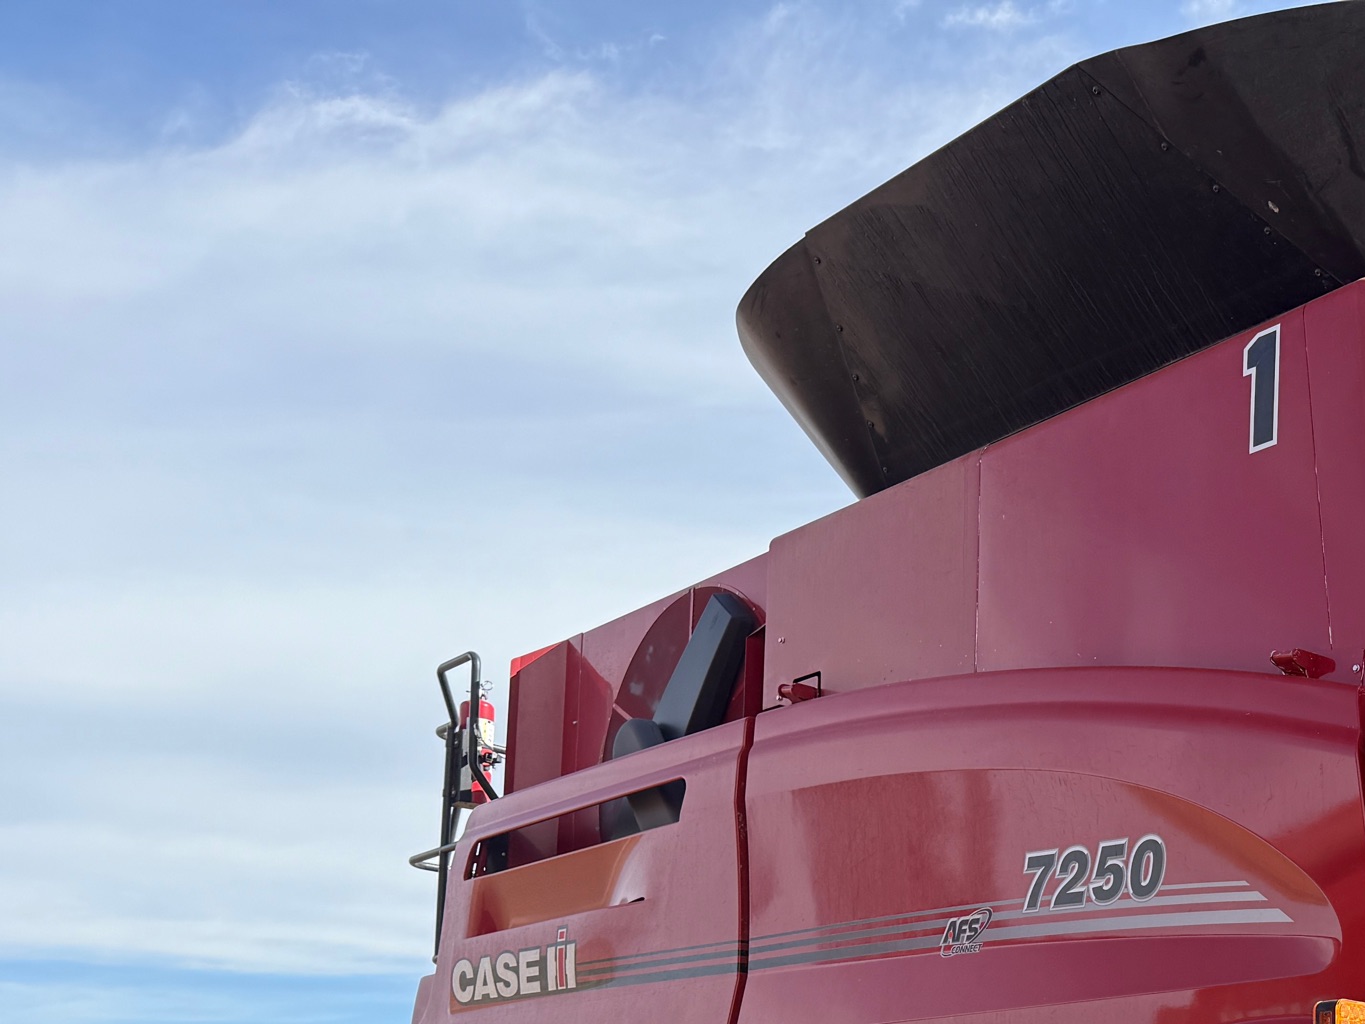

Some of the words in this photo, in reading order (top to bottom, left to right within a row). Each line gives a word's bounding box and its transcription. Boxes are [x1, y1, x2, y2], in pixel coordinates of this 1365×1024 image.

[1242, 322, 1281, 455] 1
[1022, 833, 1166, 913] 7250
[940, 914, 983, 946] AFS
[951, 942, 983, 954] CONNECT
[452, 948, 541, 1003] CASE
